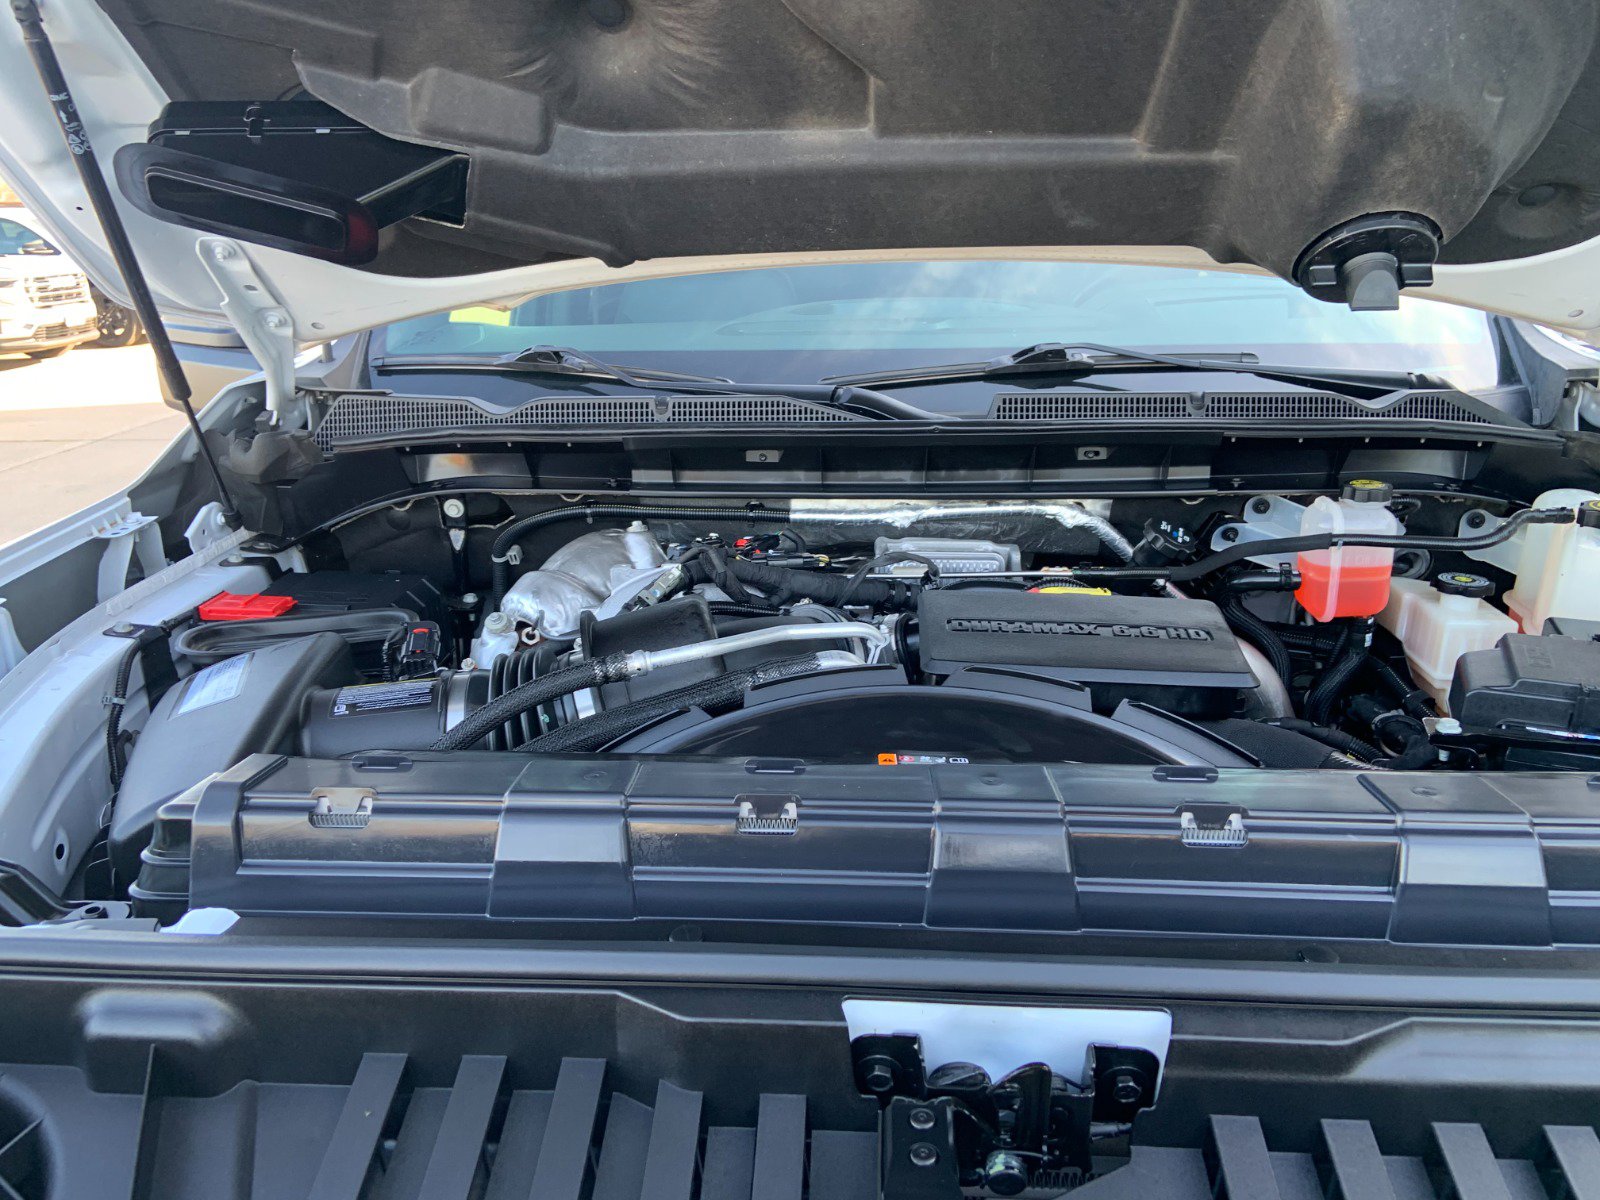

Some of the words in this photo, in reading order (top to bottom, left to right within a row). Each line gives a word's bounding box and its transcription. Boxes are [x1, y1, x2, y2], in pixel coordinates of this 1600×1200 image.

[949, 619, 1101, 635] DURAMAX
[1111, 625, 1161, 638] 6.6
[1164, 627, 1213, 641] HD
